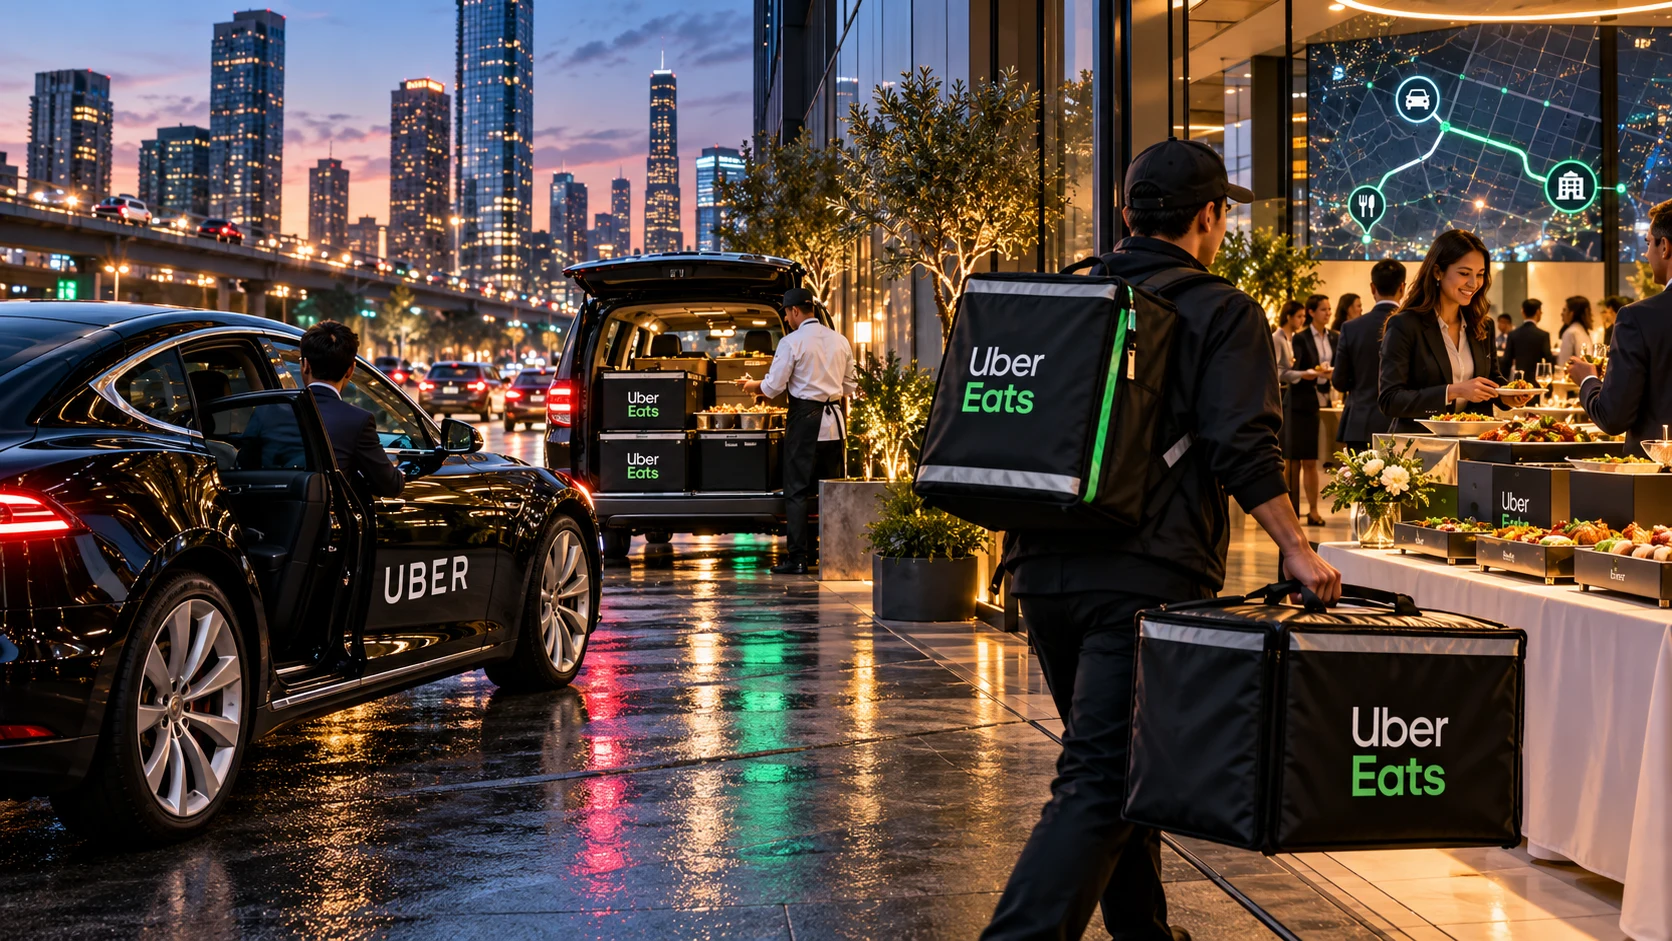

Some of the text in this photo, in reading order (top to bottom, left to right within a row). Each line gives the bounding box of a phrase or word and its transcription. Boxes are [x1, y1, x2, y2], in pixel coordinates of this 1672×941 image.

[970, 346, 1045, 377] Uber
[627, 391, 659, 404] Uber
[961, 381, 1035, 414] Eats
[628, 405, 659, 418] Eats
[627, 452, 659, 466] Uber
[627, 466, 659, 479] Eats
[1501, 491, 1530, 513] Uber
[384, 555, 469, 604] UBER
[1352, 706, 1449, 748] Uber
[1352, 755, 1446, 797] Eats
